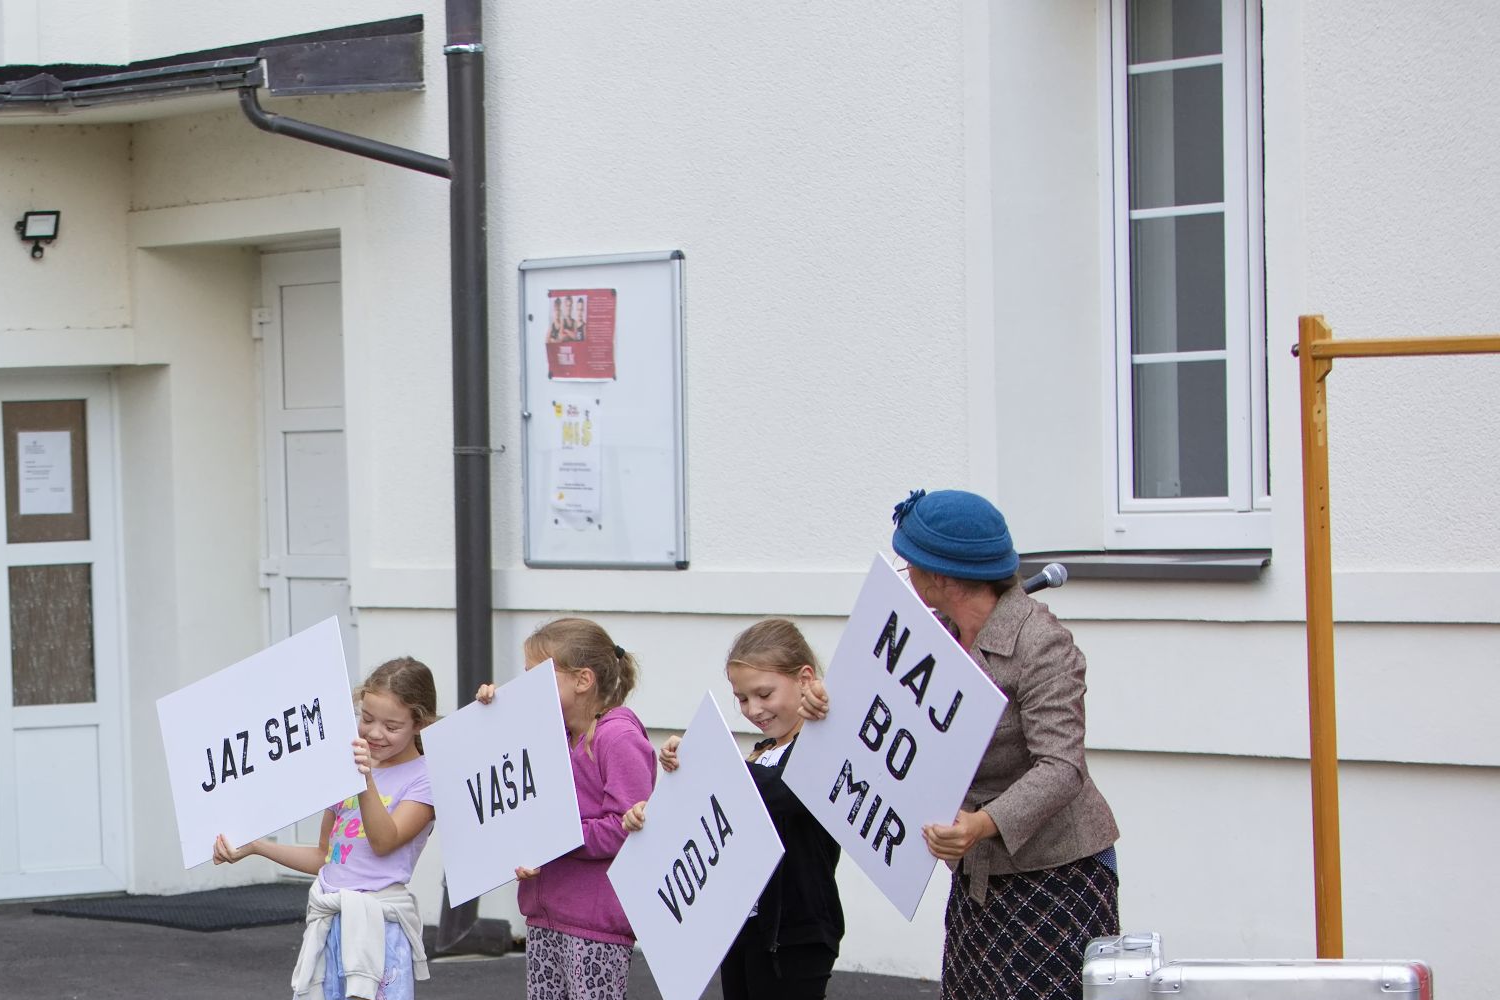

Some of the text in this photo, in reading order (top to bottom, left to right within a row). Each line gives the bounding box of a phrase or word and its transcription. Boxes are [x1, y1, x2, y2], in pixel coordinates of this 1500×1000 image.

[873, 610, 964, 733] NAJ
[201, 697, 325, 793] JAZ SEM
[466, 748, 537, 825] VAŠA
[858, 693, 918, 781] BO
[657, 793, 734, 924] VODJA
[828, 758, 906, 868] MIR
